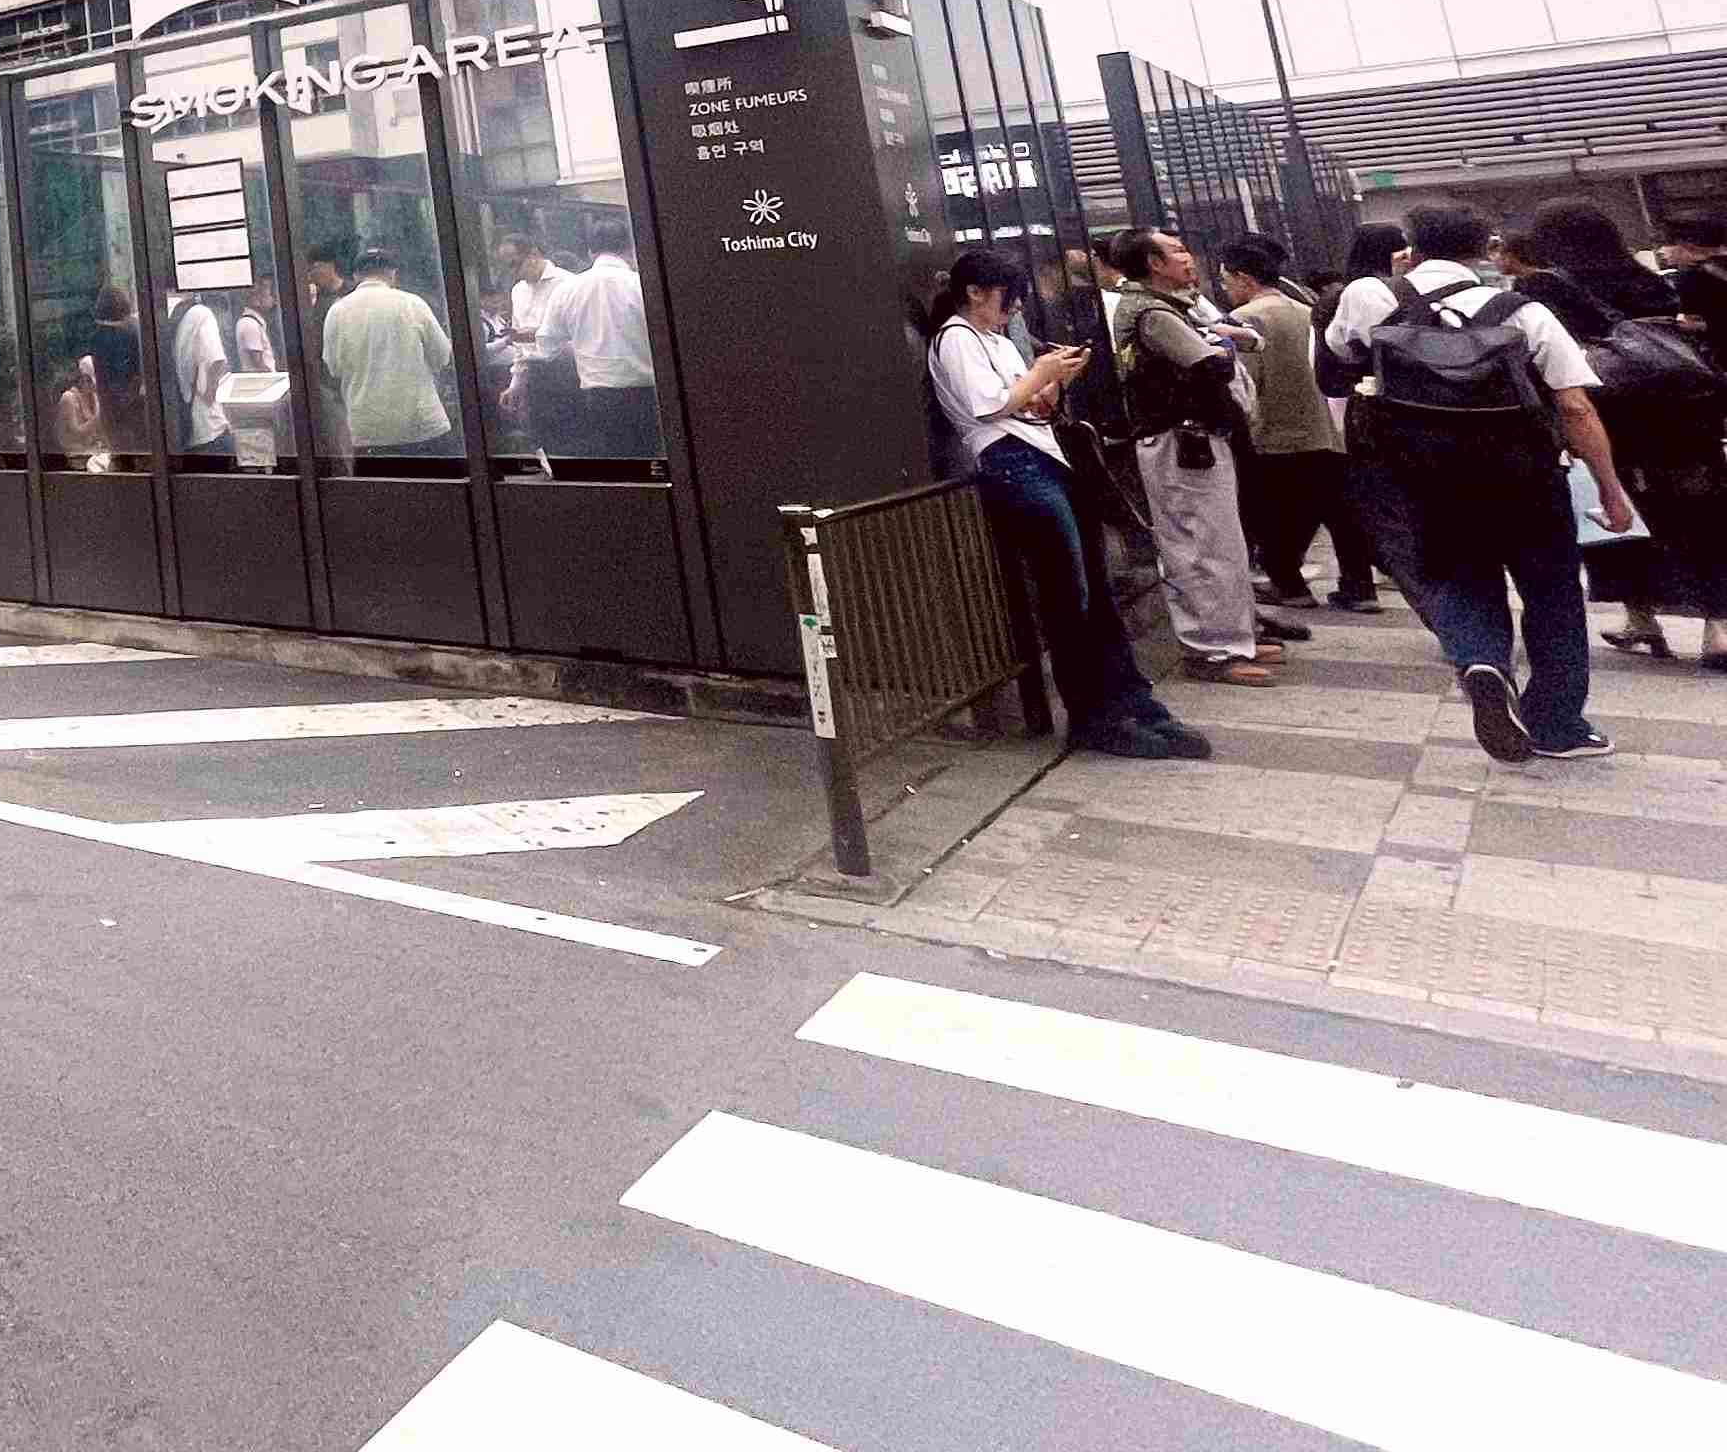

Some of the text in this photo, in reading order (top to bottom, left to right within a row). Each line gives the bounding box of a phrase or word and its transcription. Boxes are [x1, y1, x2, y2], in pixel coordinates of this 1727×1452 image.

[129, 19, 596, 129] SMOKING AREA
[688, 89, 808, 116] ZONE FUMEURS
[721, 231, 819, 252] Toshima City
